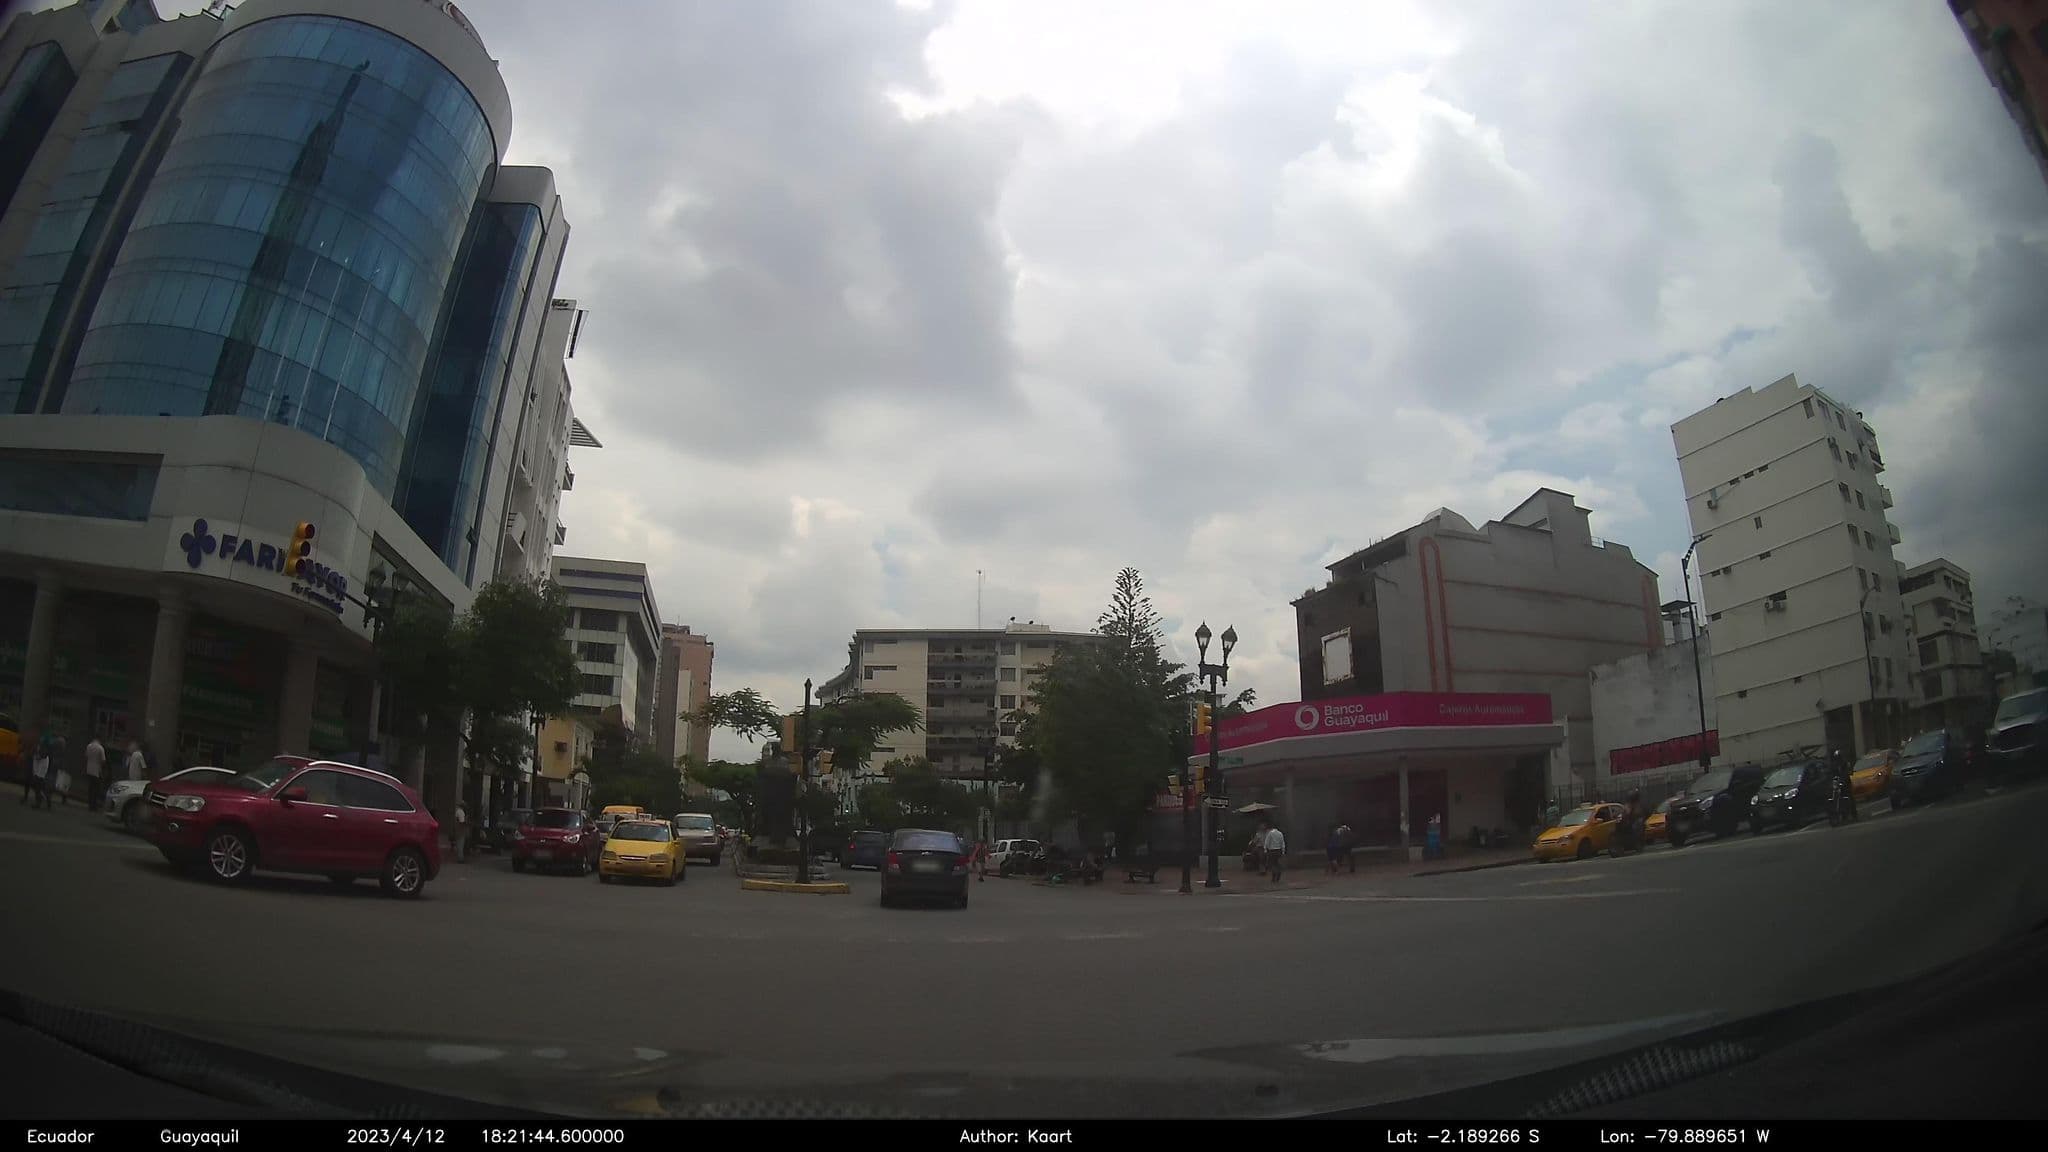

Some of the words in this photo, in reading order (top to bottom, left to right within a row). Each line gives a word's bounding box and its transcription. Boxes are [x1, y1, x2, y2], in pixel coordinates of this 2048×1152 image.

[219, 534, 348, 601] FARAYOR
[1324, 704, 1364, 716] Banco
[1324, 709, 1389, 727] Guayaquil
